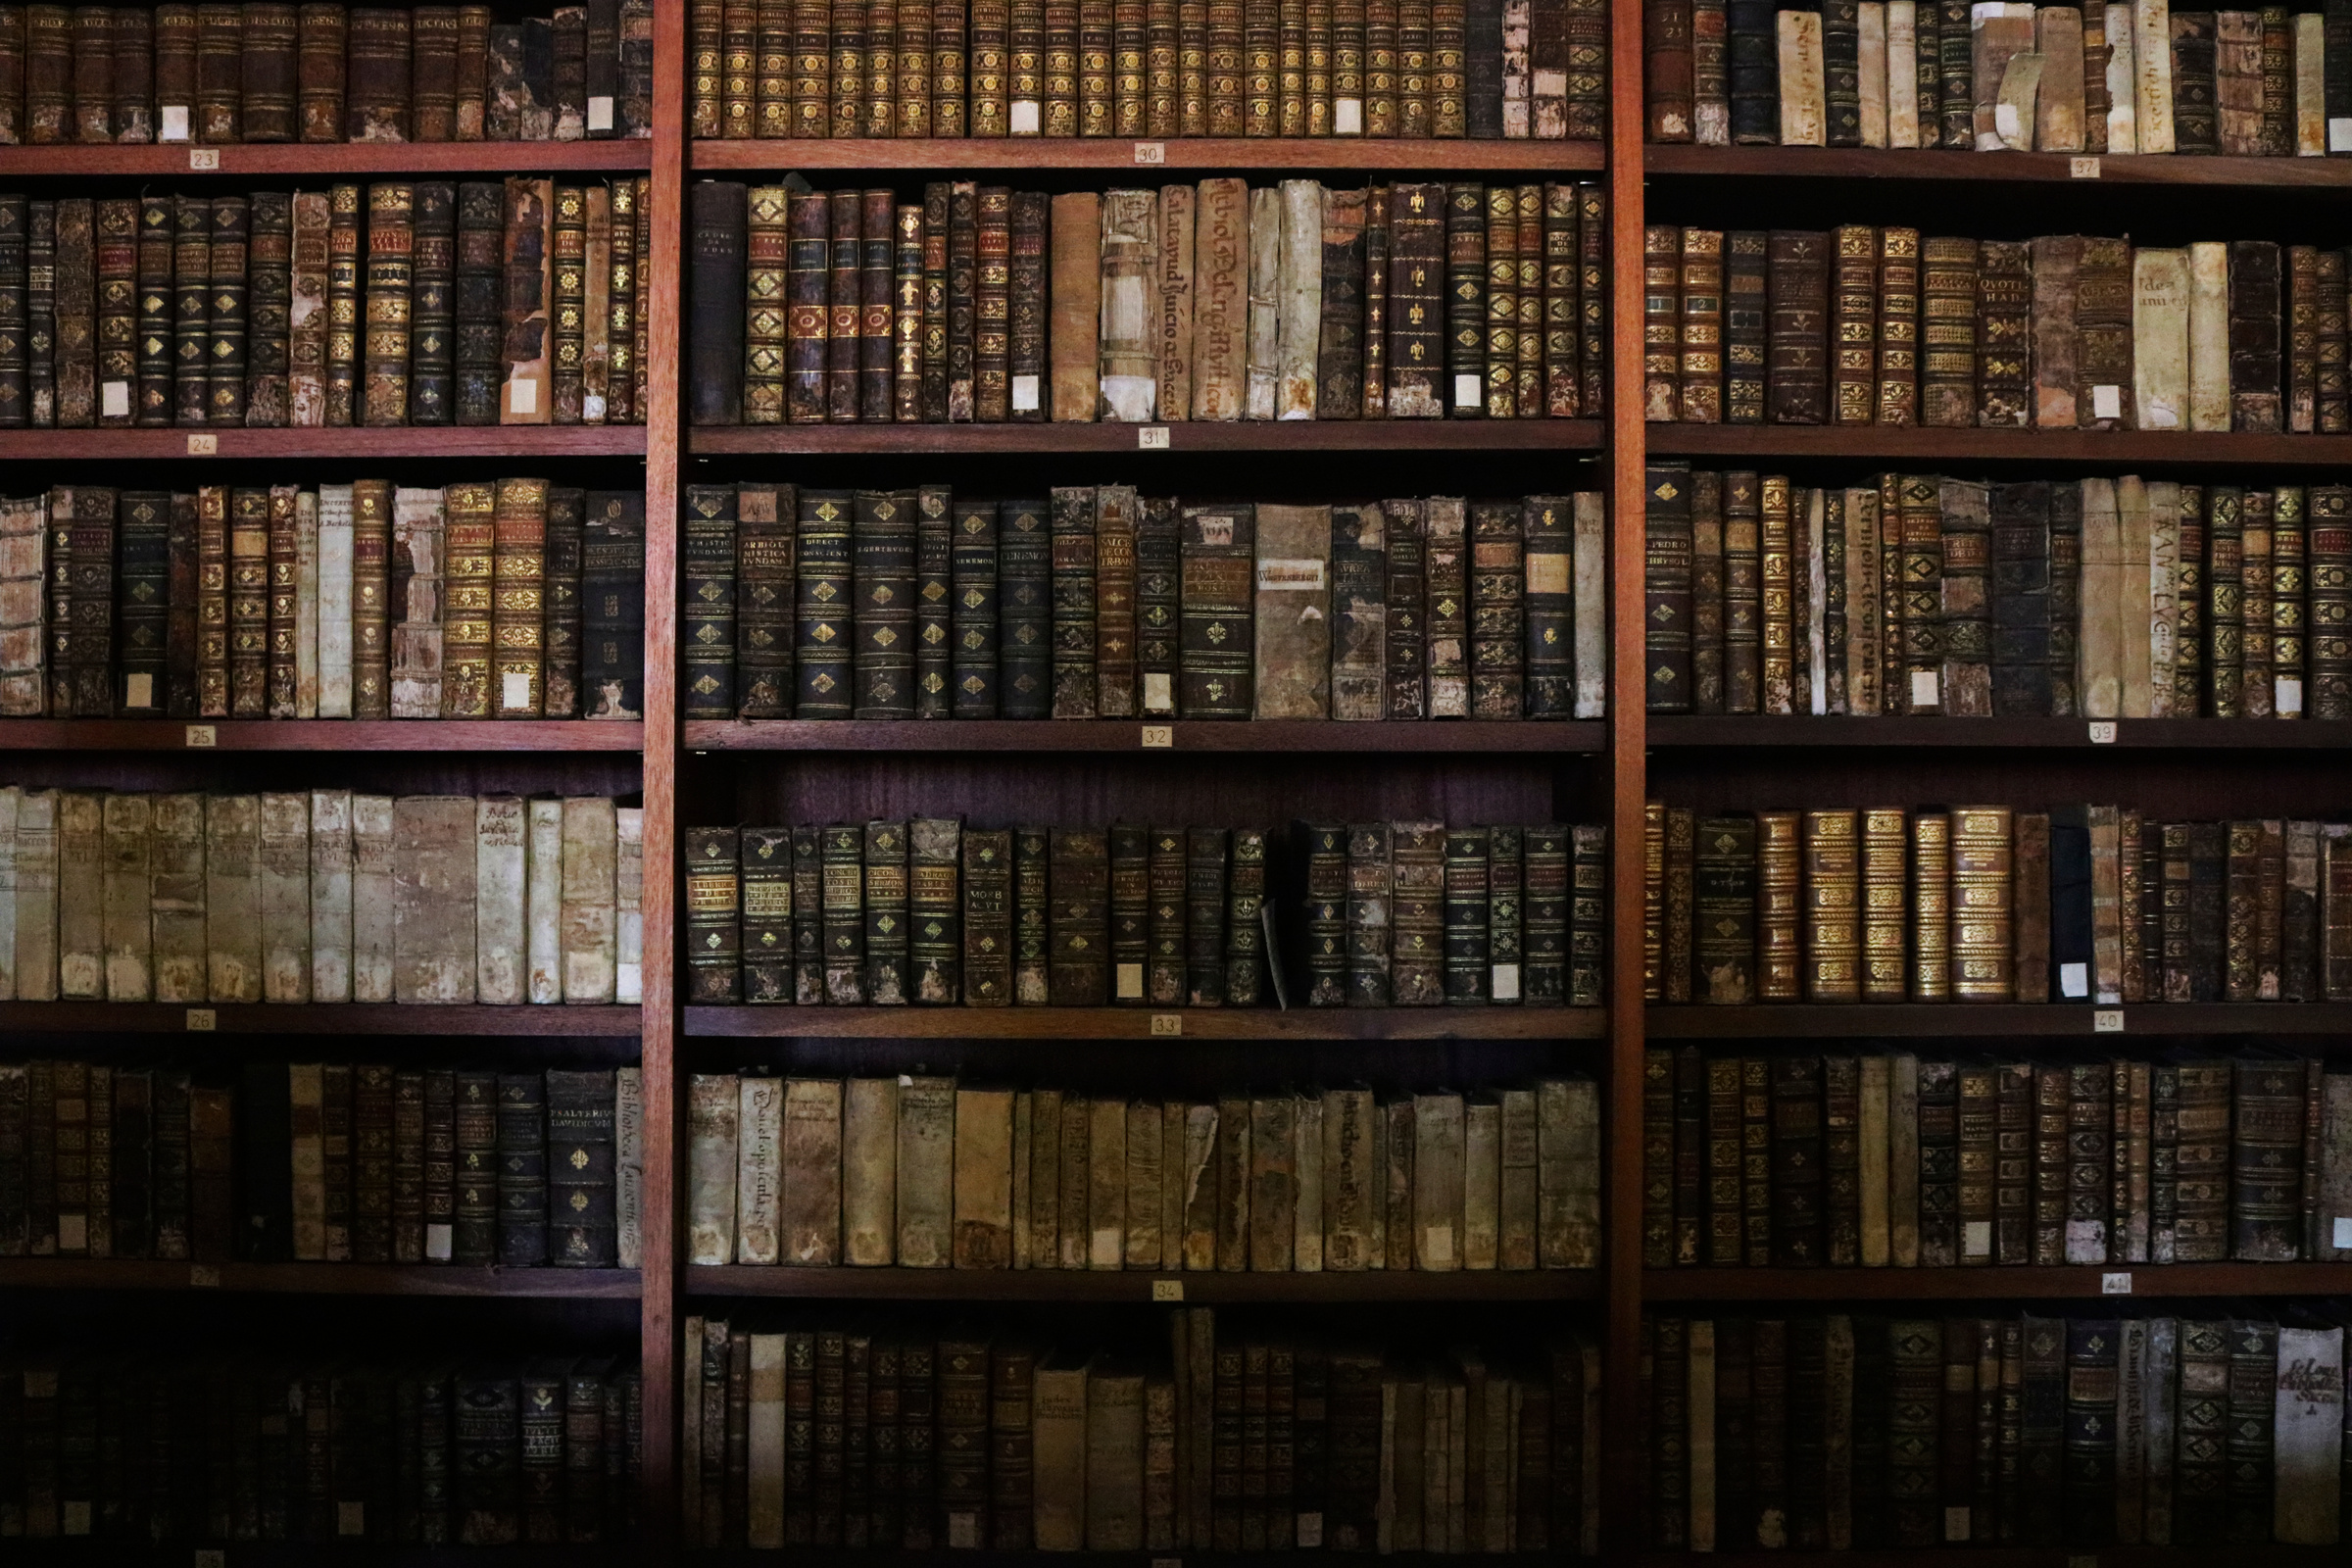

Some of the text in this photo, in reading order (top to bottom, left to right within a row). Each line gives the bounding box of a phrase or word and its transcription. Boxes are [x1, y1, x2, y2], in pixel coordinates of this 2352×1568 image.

[194, 154, 214, 167] 23
[1138, 148, 1157, 161] 30
[2075, 161, 2094, 173] 37
[1144, 431, 1159, 444] 31
[194, 439, 211, 451] 24
[192, 730, 211, 744] 25
[1146, 729, 1166, 743] 32
[2092, 726, 2112, 740] 39
[192, 1014, 210, 1028] 26
[1154, 1018, 1175, 1032] 33
[2098, 1014, 2118, 1027] 40
[1156, 1284, 1175, 1298] 34
